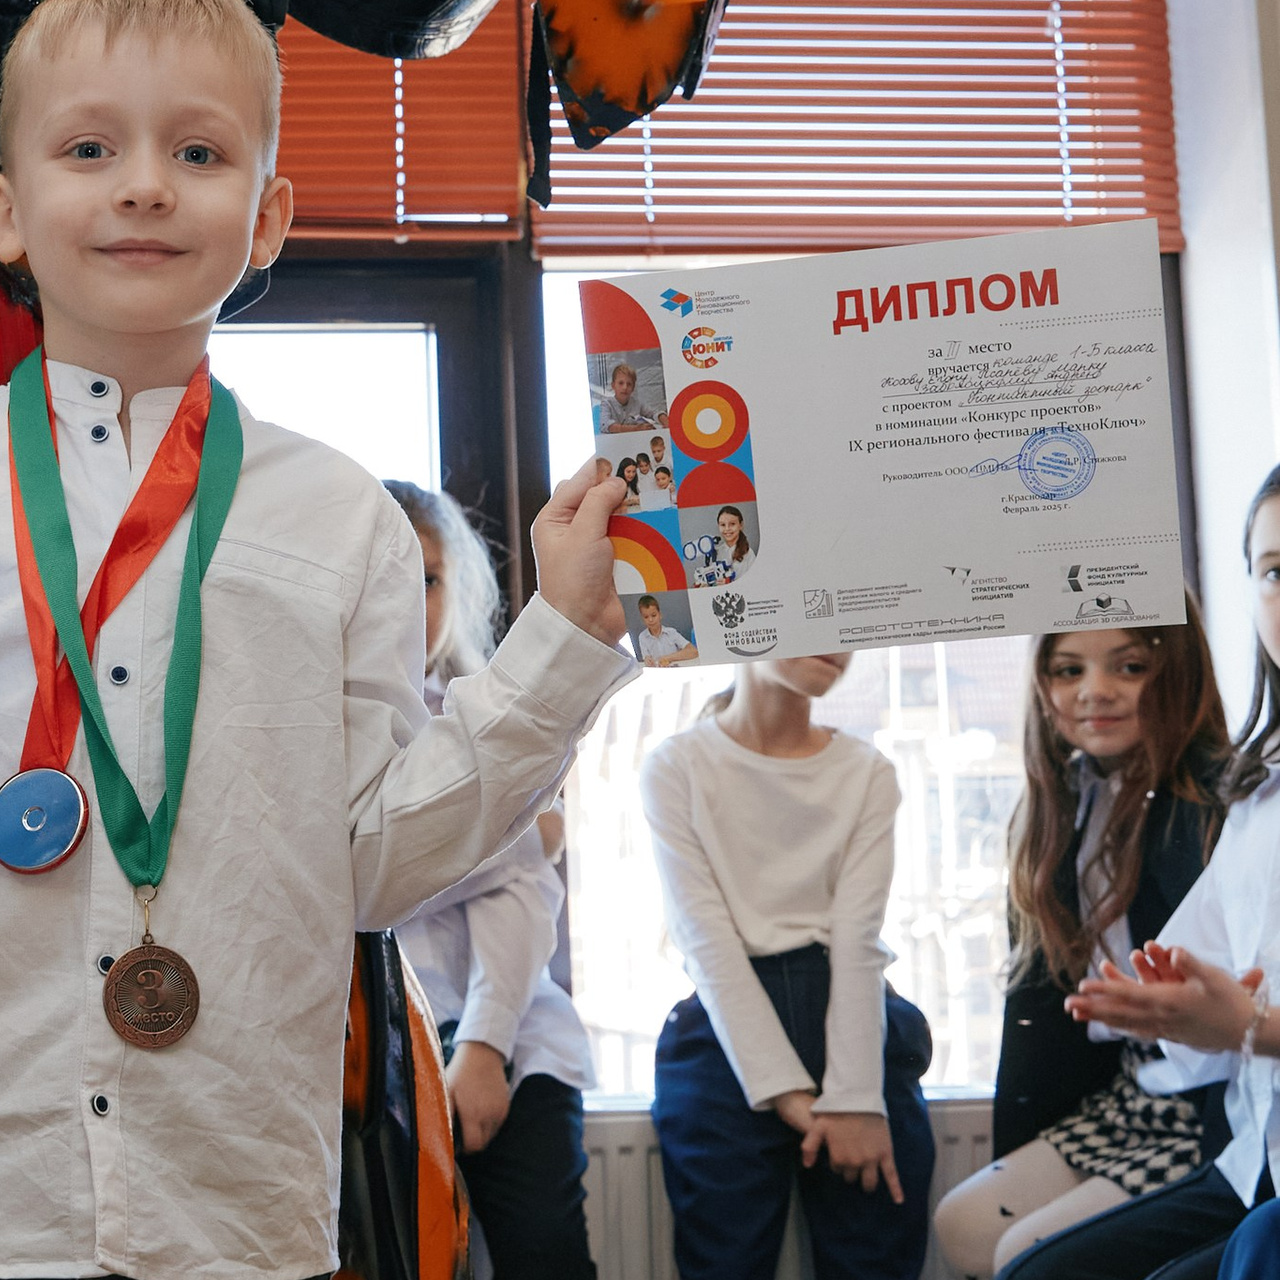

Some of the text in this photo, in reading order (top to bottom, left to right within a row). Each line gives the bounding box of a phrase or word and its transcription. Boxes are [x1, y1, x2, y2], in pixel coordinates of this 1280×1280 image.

[696, 300, 751, 310] Инновационного
[832, 268, 1059, 335] ДИПЛОМ
[696, 308, 734, 316] Творчества
[692, 340, 734, 355] ЮНИТ
[928, 348, 943, 358] за
[968, 341, 1012, 355] место
[928, 362, 990, 377] вручается
[1104, 342, 1158, 356] класса
[882, 404, 888, 413] с
[892, 399, 952, 415] проектом
[875, 403, 1102, 432] в номинации «Конкурс проектов»
[848, 440, 864, 452] IX
[866, 432, 970, 454] регионального
[973, 426, 1046, 444] фестиваля
[1051, 416, 1146, 433] «ТехноКлюч»
[882, 471, 943, 484] Руководитель
[944, 466, 968, 476] ООО
[1002, 505, 1040, 515] Февраль
[1042, 504, 1062, 512] 2025
[1086, 564, 1140, 572] ПРЕЗИДЕНТСКИЙ
[970, 576, 1008, 585] АГЕНТСТВО
[970, 583, 1030, 594] СТРАТЕГИЧЕСКИХ
[972, 592, 1014, 601] ИНИЦИАТИВ
[838, 614, 1005, 636] РОБОТОТЕХНИКА
[1052, 618, 1099, 628] АССОЦИАЦИЯ
[1111, 613, 1160, 623] ОБРАЗОВАНИЯ
[742, 628, 776, 638] СОДЕЙСТВИЯ
[913, 630, 932, 638] кадры
[724, 634, 778, 646] ИННОВАЦИЯМ
[137, 970, 164, 1009] 3
[133, 1012, 174, 1023] место
